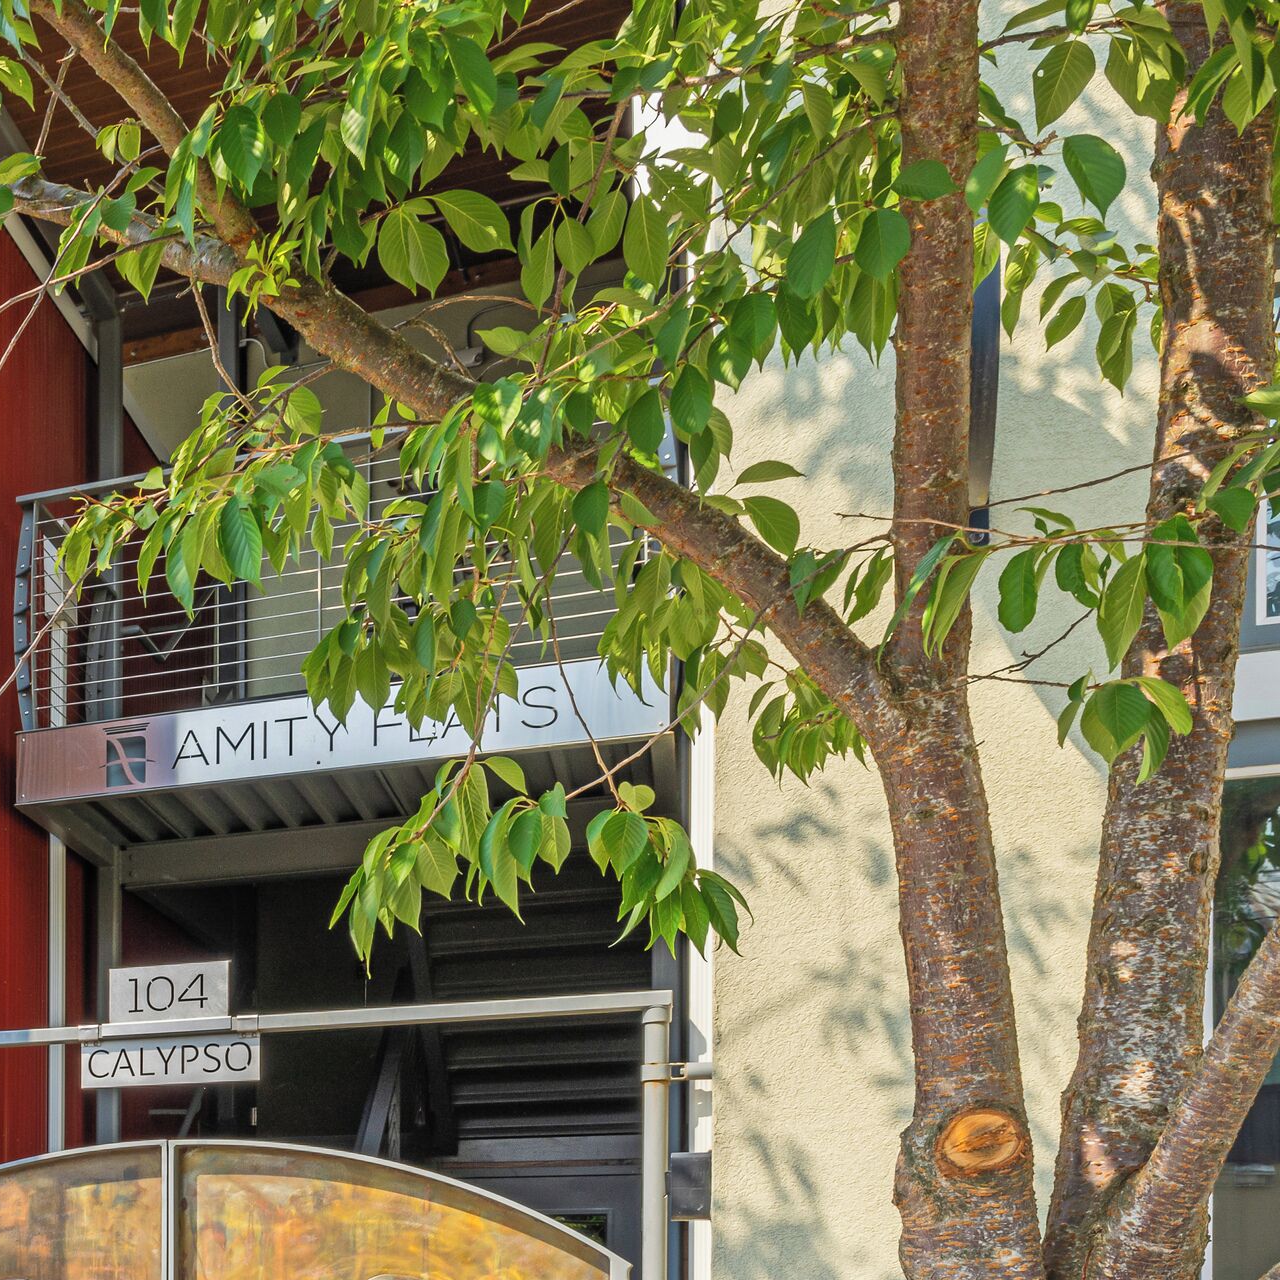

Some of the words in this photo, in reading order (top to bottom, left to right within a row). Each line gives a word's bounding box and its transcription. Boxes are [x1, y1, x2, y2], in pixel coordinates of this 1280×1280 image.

[171, 711, 346, 770] AMITY
[128, 974, 209, 1014] 104
[86, 1040, 253, 1079] CALYPSO
